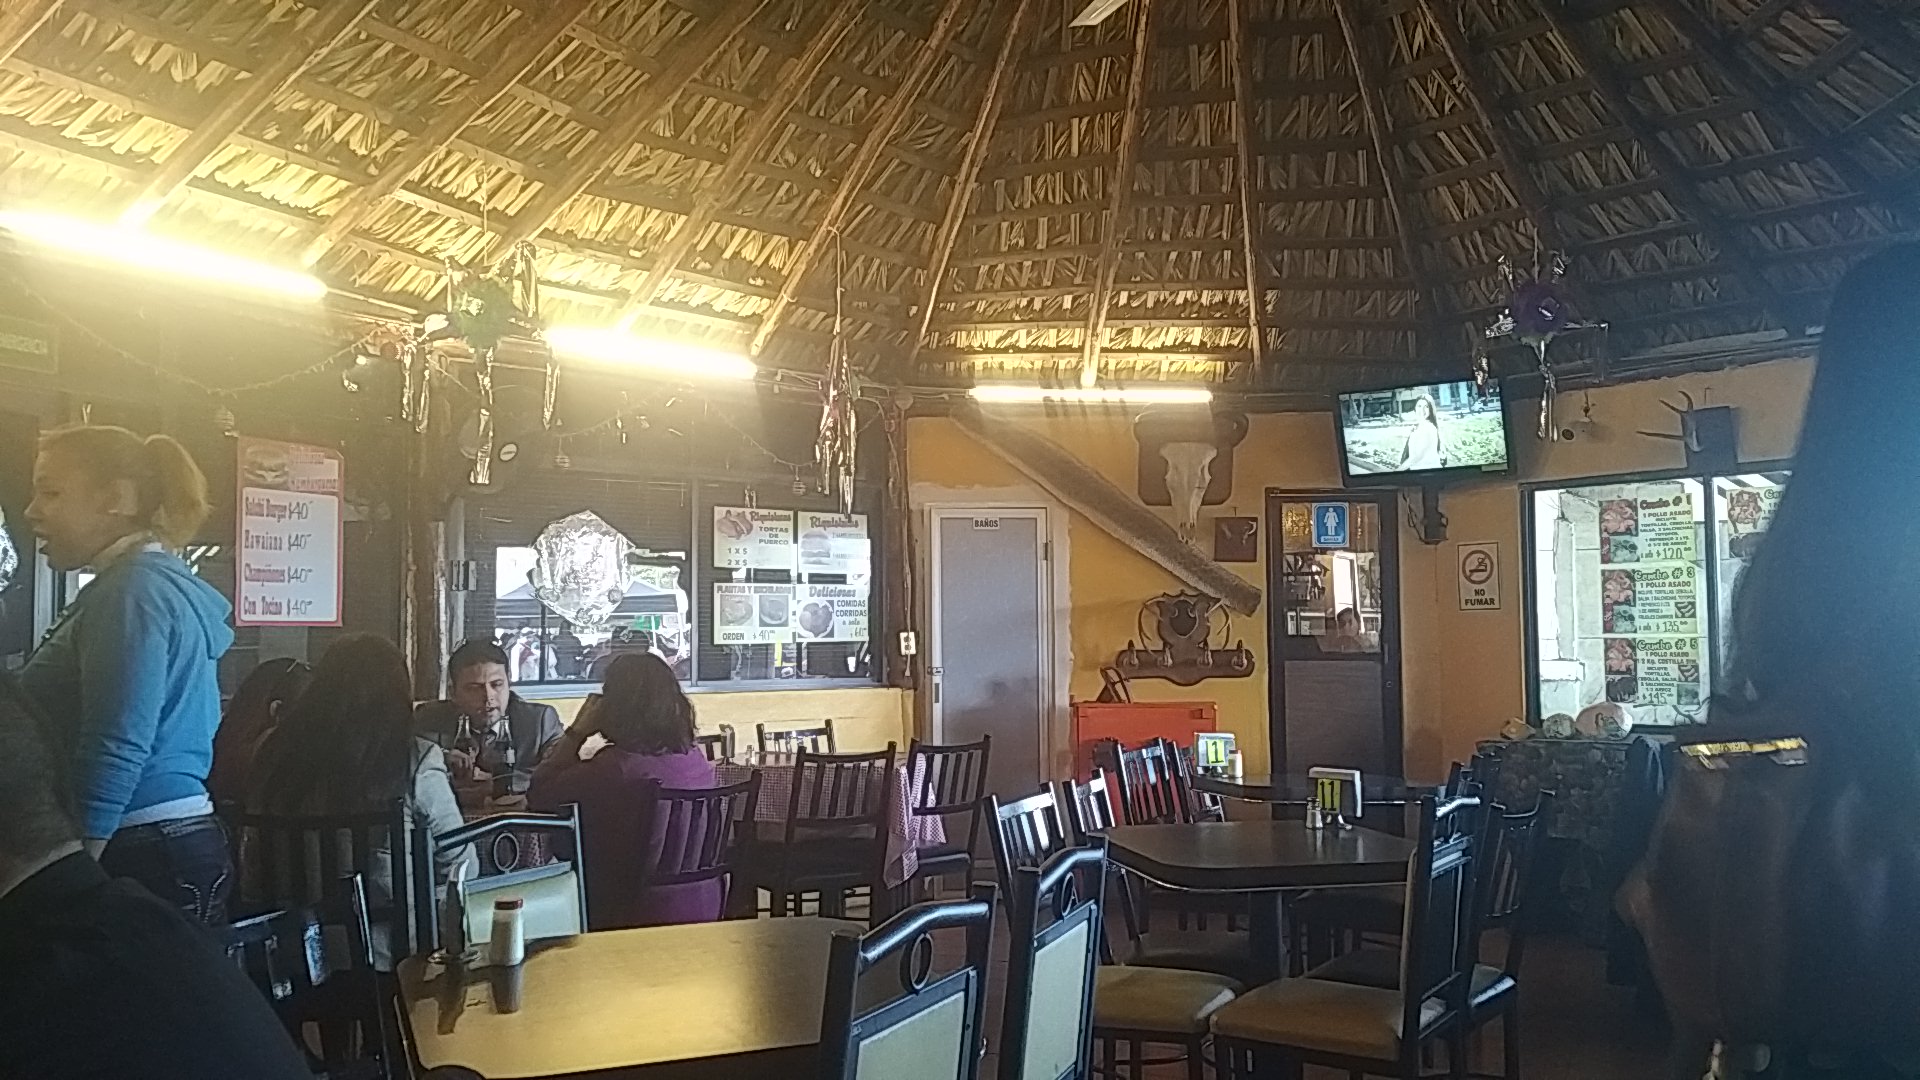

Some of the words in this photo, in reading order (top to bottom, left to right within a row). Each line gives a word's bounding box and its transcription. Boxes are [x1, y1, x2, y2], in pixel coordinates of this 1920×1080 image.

[974, 518, 999, 528] BAÑOS
[244, 529, 283, 551] Hawaiana
[1634, 568, 1670, 581] Combo
[1671, 567, 1684, 579] #
[1686, 565, 1696, 578] 3
[1668, 580, 1692, 588] ASADO
[747, 585, 753, 594] Y
[1473, 588, 1486, 597] NO
[836, 599, 867, 608] COMIDAS
[1464, 598, 1496, 607] FUMAR
[835, 609, 868, 618] CORRIDAS
[722, 633, 745, 641] ORDEN
[1637, 639, 1673, 652] Combo
[1674, 638, 1687, 651] #
[1689, 637, 1699, 650] 5
[1212, 740, 1224, 764] 1
[1319, 780, 1337, 811] 11
